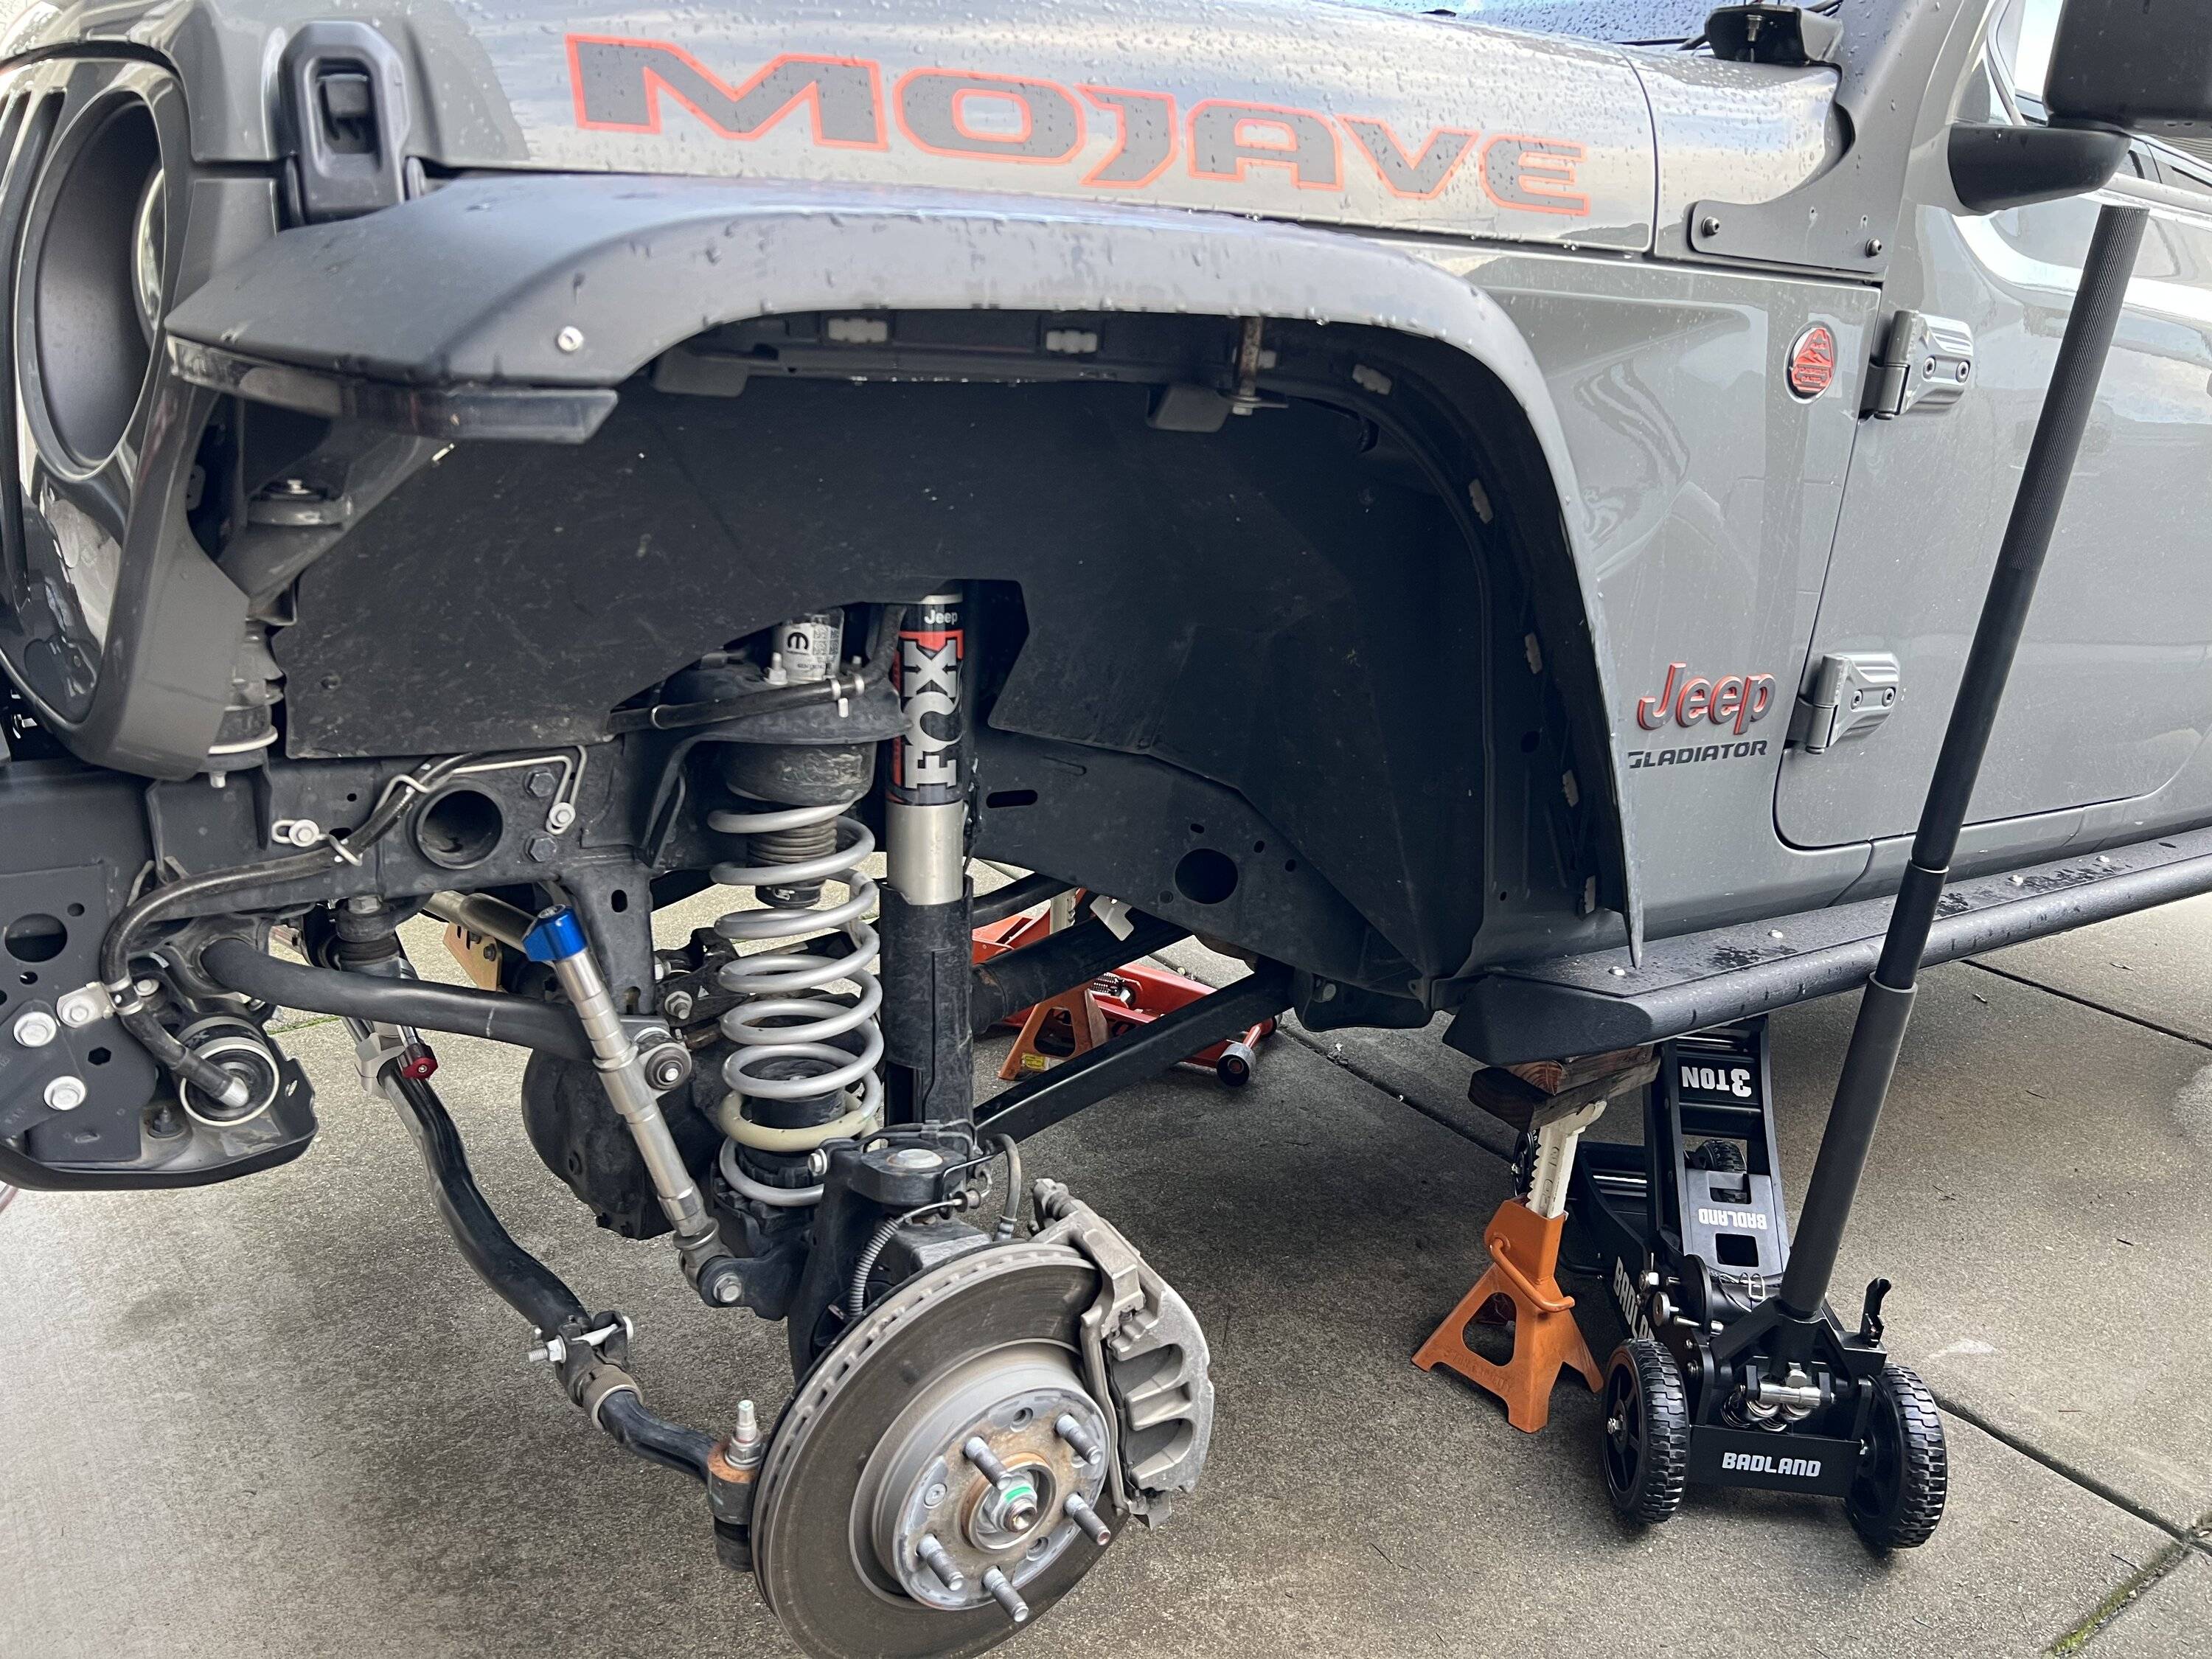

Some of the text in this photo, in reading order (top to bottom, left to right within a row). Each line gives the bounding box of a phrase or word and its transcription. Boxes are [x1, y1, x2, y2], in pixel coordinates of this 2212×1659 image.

[565, 33, 1590, 215] MOJAVE
[924, 609, 958, 625] Jeep
[901, 639, 962, 789] FOX
[1637, 662, 1776, 735] Jeep
[1628, 740, 1768, 769] GLADIATOR
[1698, 1208, 1767, 1230] BADLAND
[1613, 1256, 1655, 1340] BADLA
[1722, 1452, 1821, 1477] BADLAND
